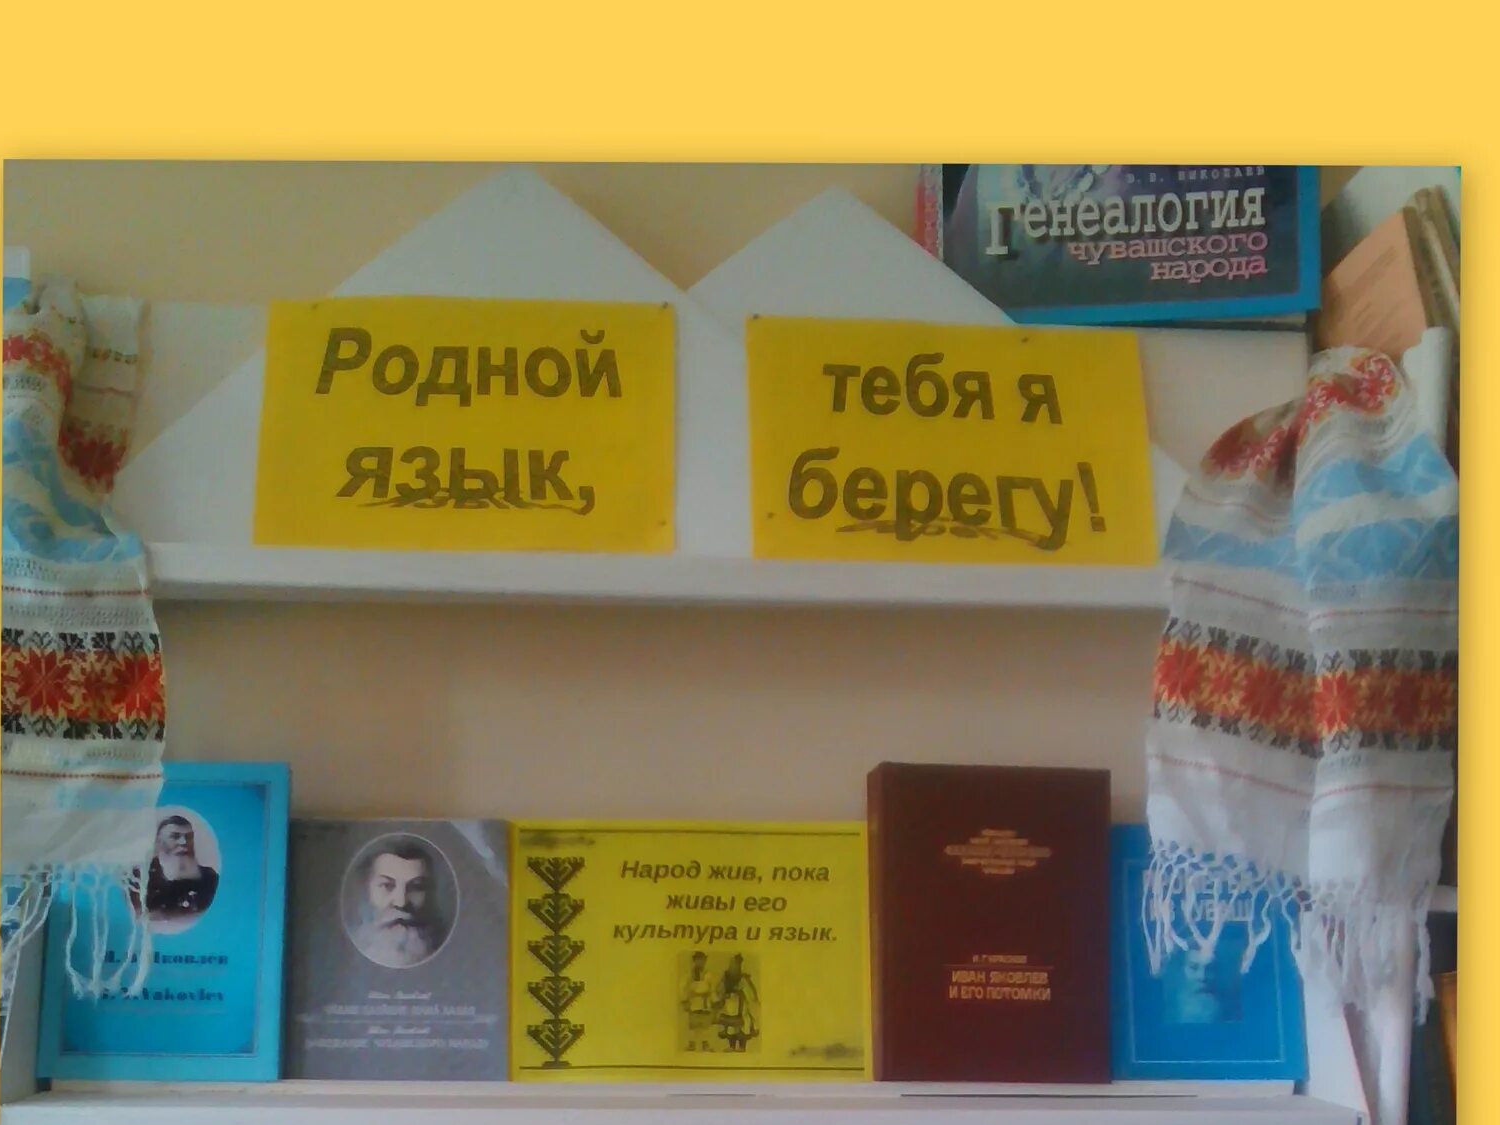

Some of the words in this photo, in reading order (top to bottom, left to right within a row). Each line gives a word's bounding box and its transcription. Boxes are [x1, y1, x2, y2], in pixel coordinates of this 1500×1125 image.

[986, 187, 1267, 256] Генеалогия
[1068, 231, 1268, 265] чувашского
[1150, 255, 1268, 284] народа
[315, 327, 621, 406] Родной
[822, 352, 995, 420] тебя
[1017, 373, 1062, 424] я
[337, 447, 596, 515] язык,
[788, 446, 1107, 551] берегу!
[620, 860, 701, 884] Народ
[708, 863, 762, 883] жив,
[772, 863, 830, 882] пока
[666, 893, 735, 911] живы
[744, 896, 787, 912] его
[612, 924, 738, 945] культура
[746, 925, 761, 941] и
[769, 924, 838, 941] язык.
[990, 971, 1048, 984] ЯКОВЛЕВ
